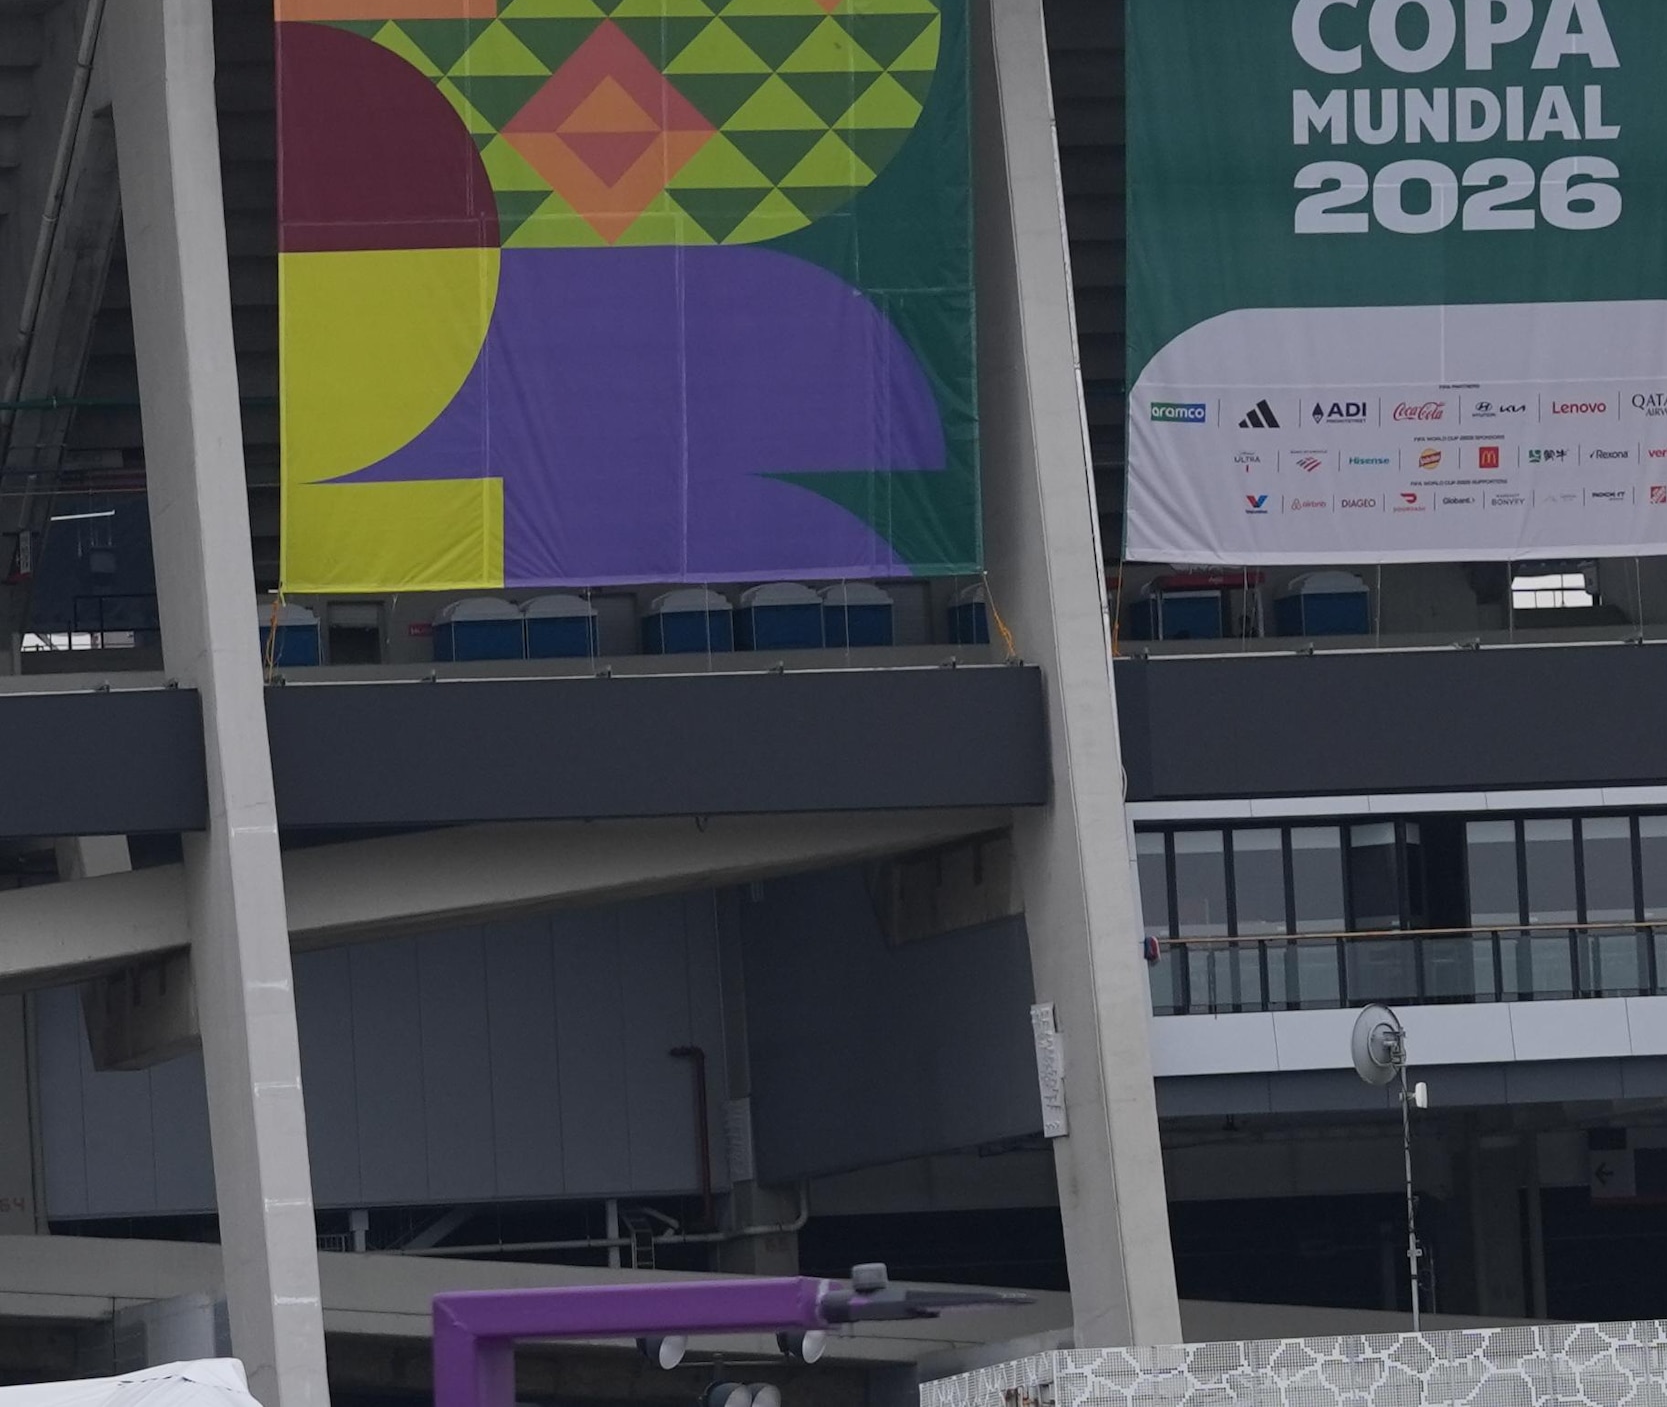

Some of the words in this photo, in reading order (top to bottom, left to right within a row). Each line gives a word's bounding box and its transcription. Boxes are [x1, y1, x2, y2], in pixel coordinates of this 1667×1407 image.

[1292, 84, 1621, 145] MUNDIAL
[1294, 155, 1622, 234] 2026
[1152, 406, 1204, 418] aramco
[1327, 402, 1366, 417] ADI
[1552, 401, 1606, 414] Lenovo
[1349, 456, 1390, 465] Hisense
[1596, 449, 1629, 460] Rexona
[1341, 498, 1376, 508] DIAGEO
